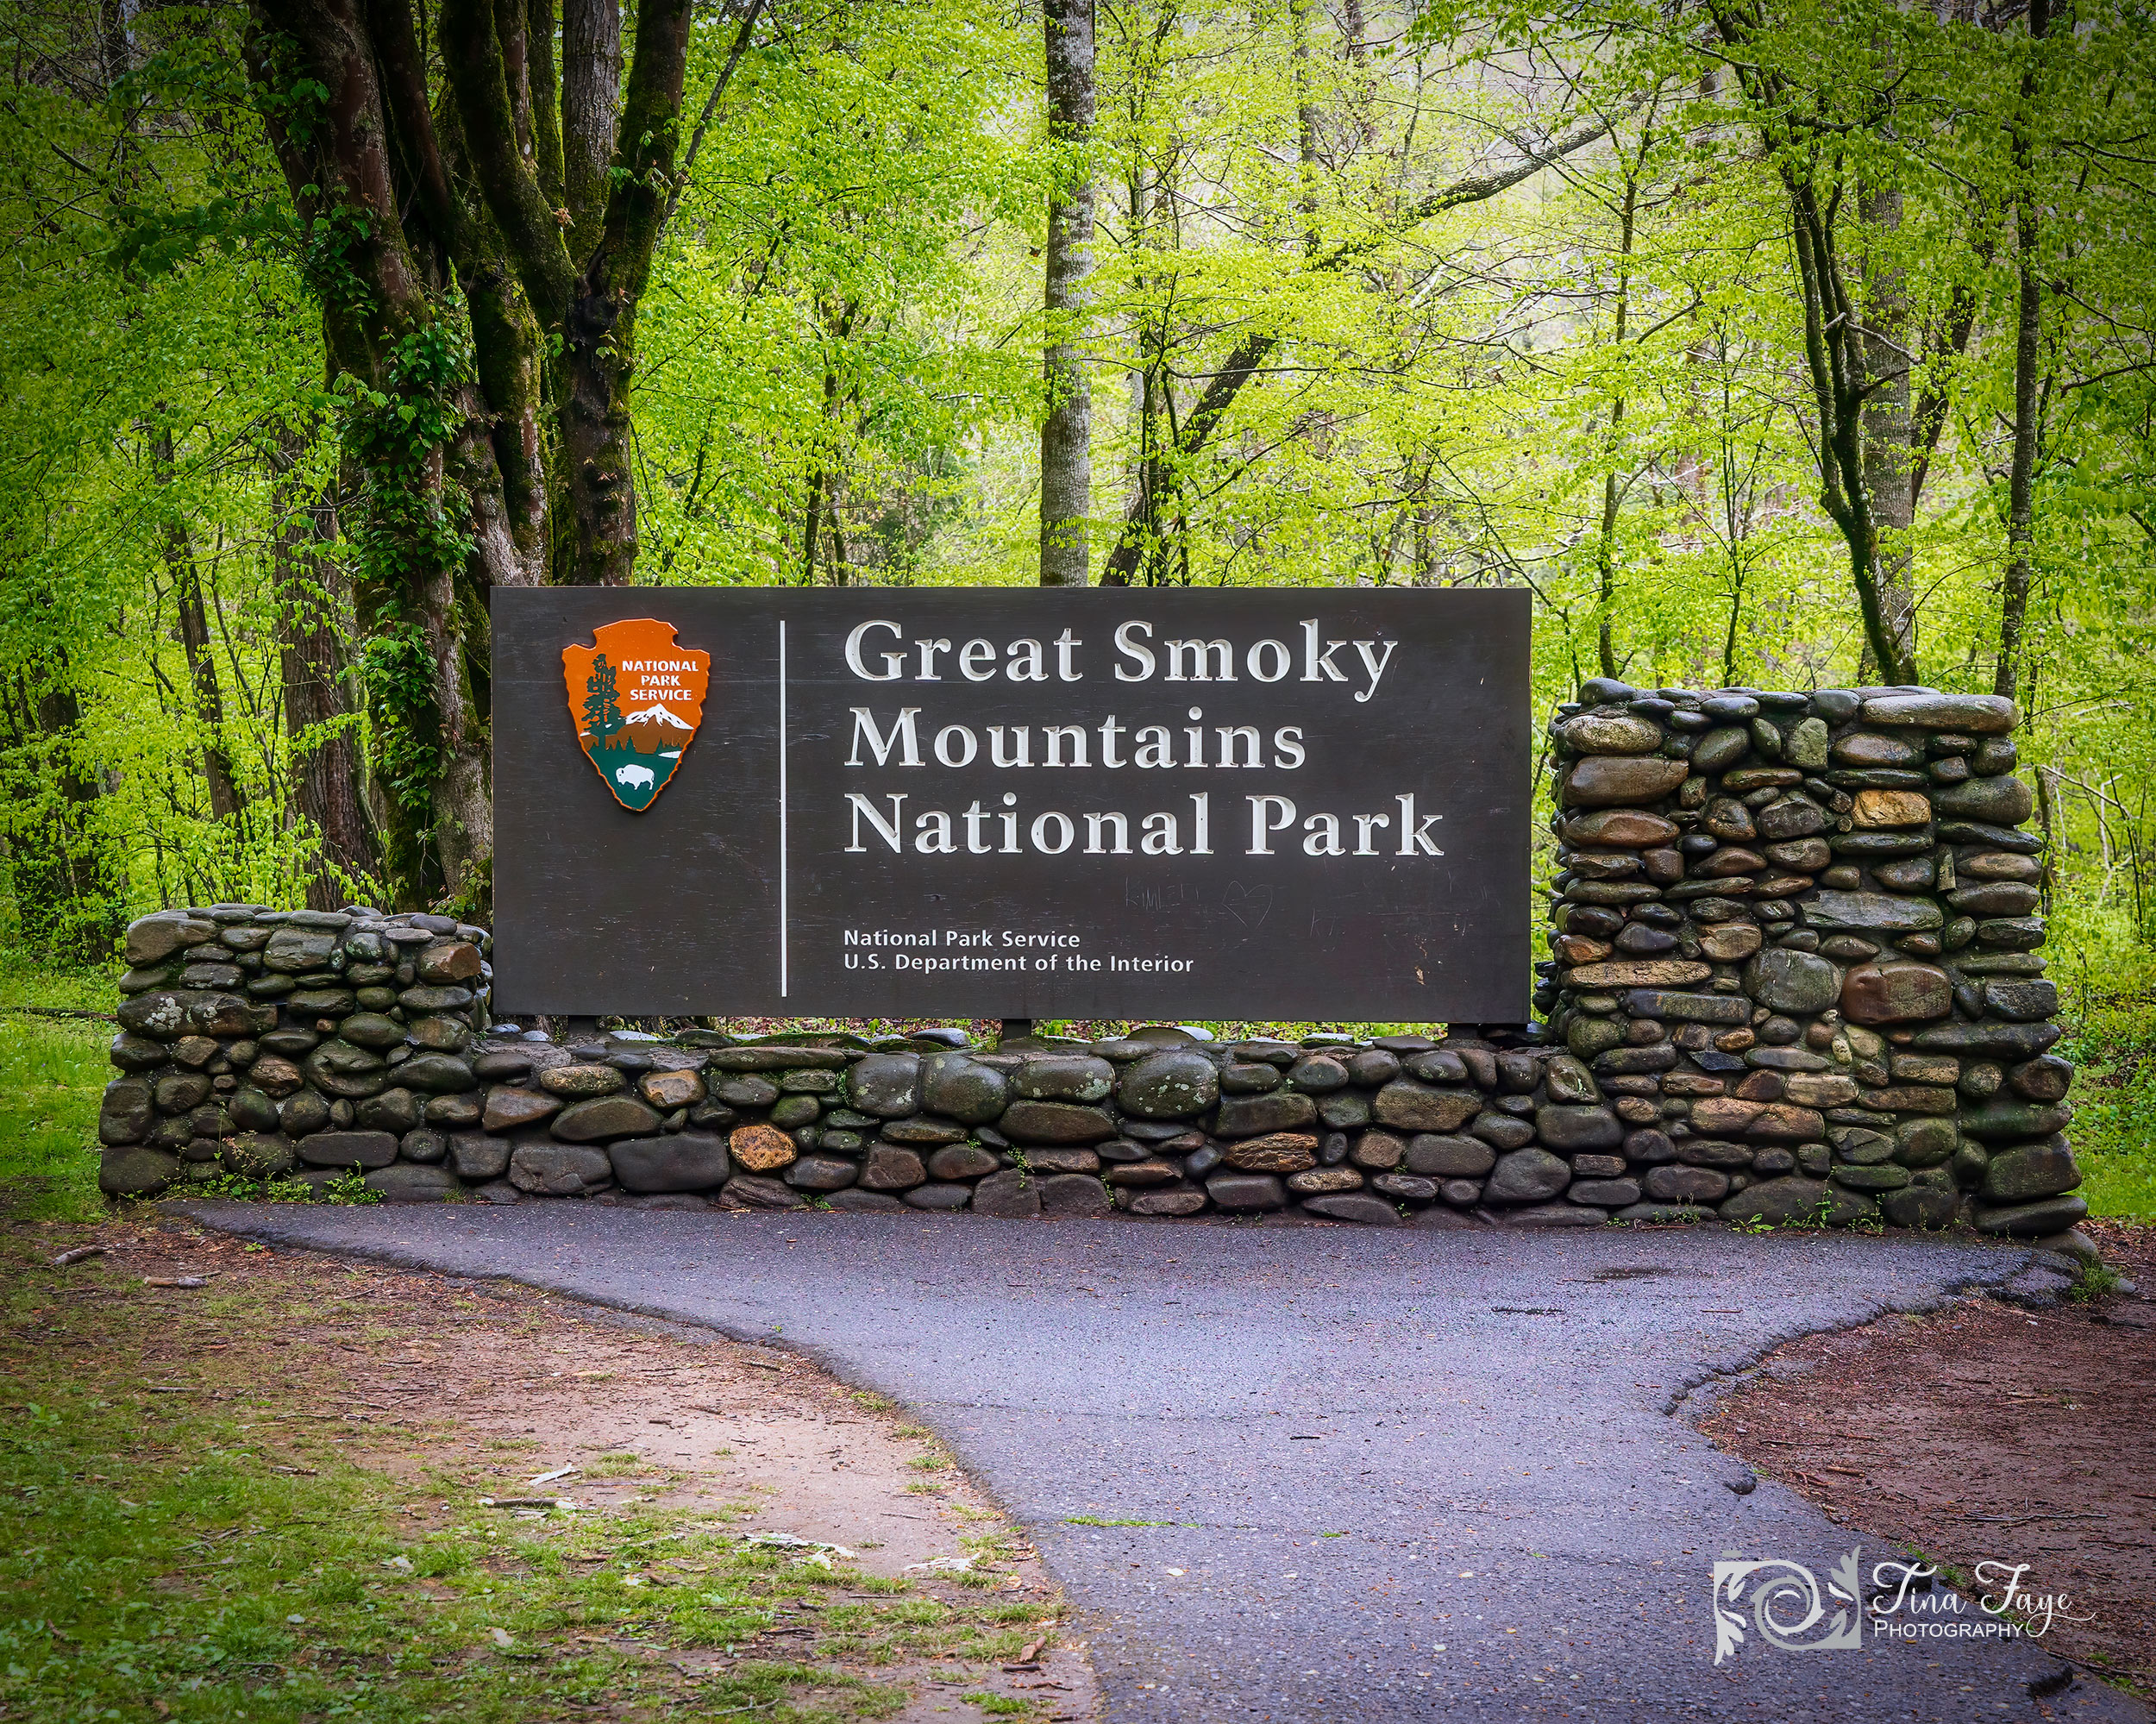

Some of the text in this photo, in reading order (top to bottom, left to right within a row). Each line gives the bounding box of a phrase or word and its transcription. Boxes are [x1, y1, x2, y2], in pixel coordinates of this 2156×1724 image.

[622, 661, 699, 672] NATIONAL
[844, 618, 1399, 703] Great Smoky
[641, 675, 681, 686] PARK
[630, 689, 693, 701] SERVICE
[843, 706, 1306, 769] Mountains
[843, 791, 1445, 856] National Park
[844, 929, 1081, 948] National Park Service
[844, 954, 1194, 975] U.S. Department of the Interior
